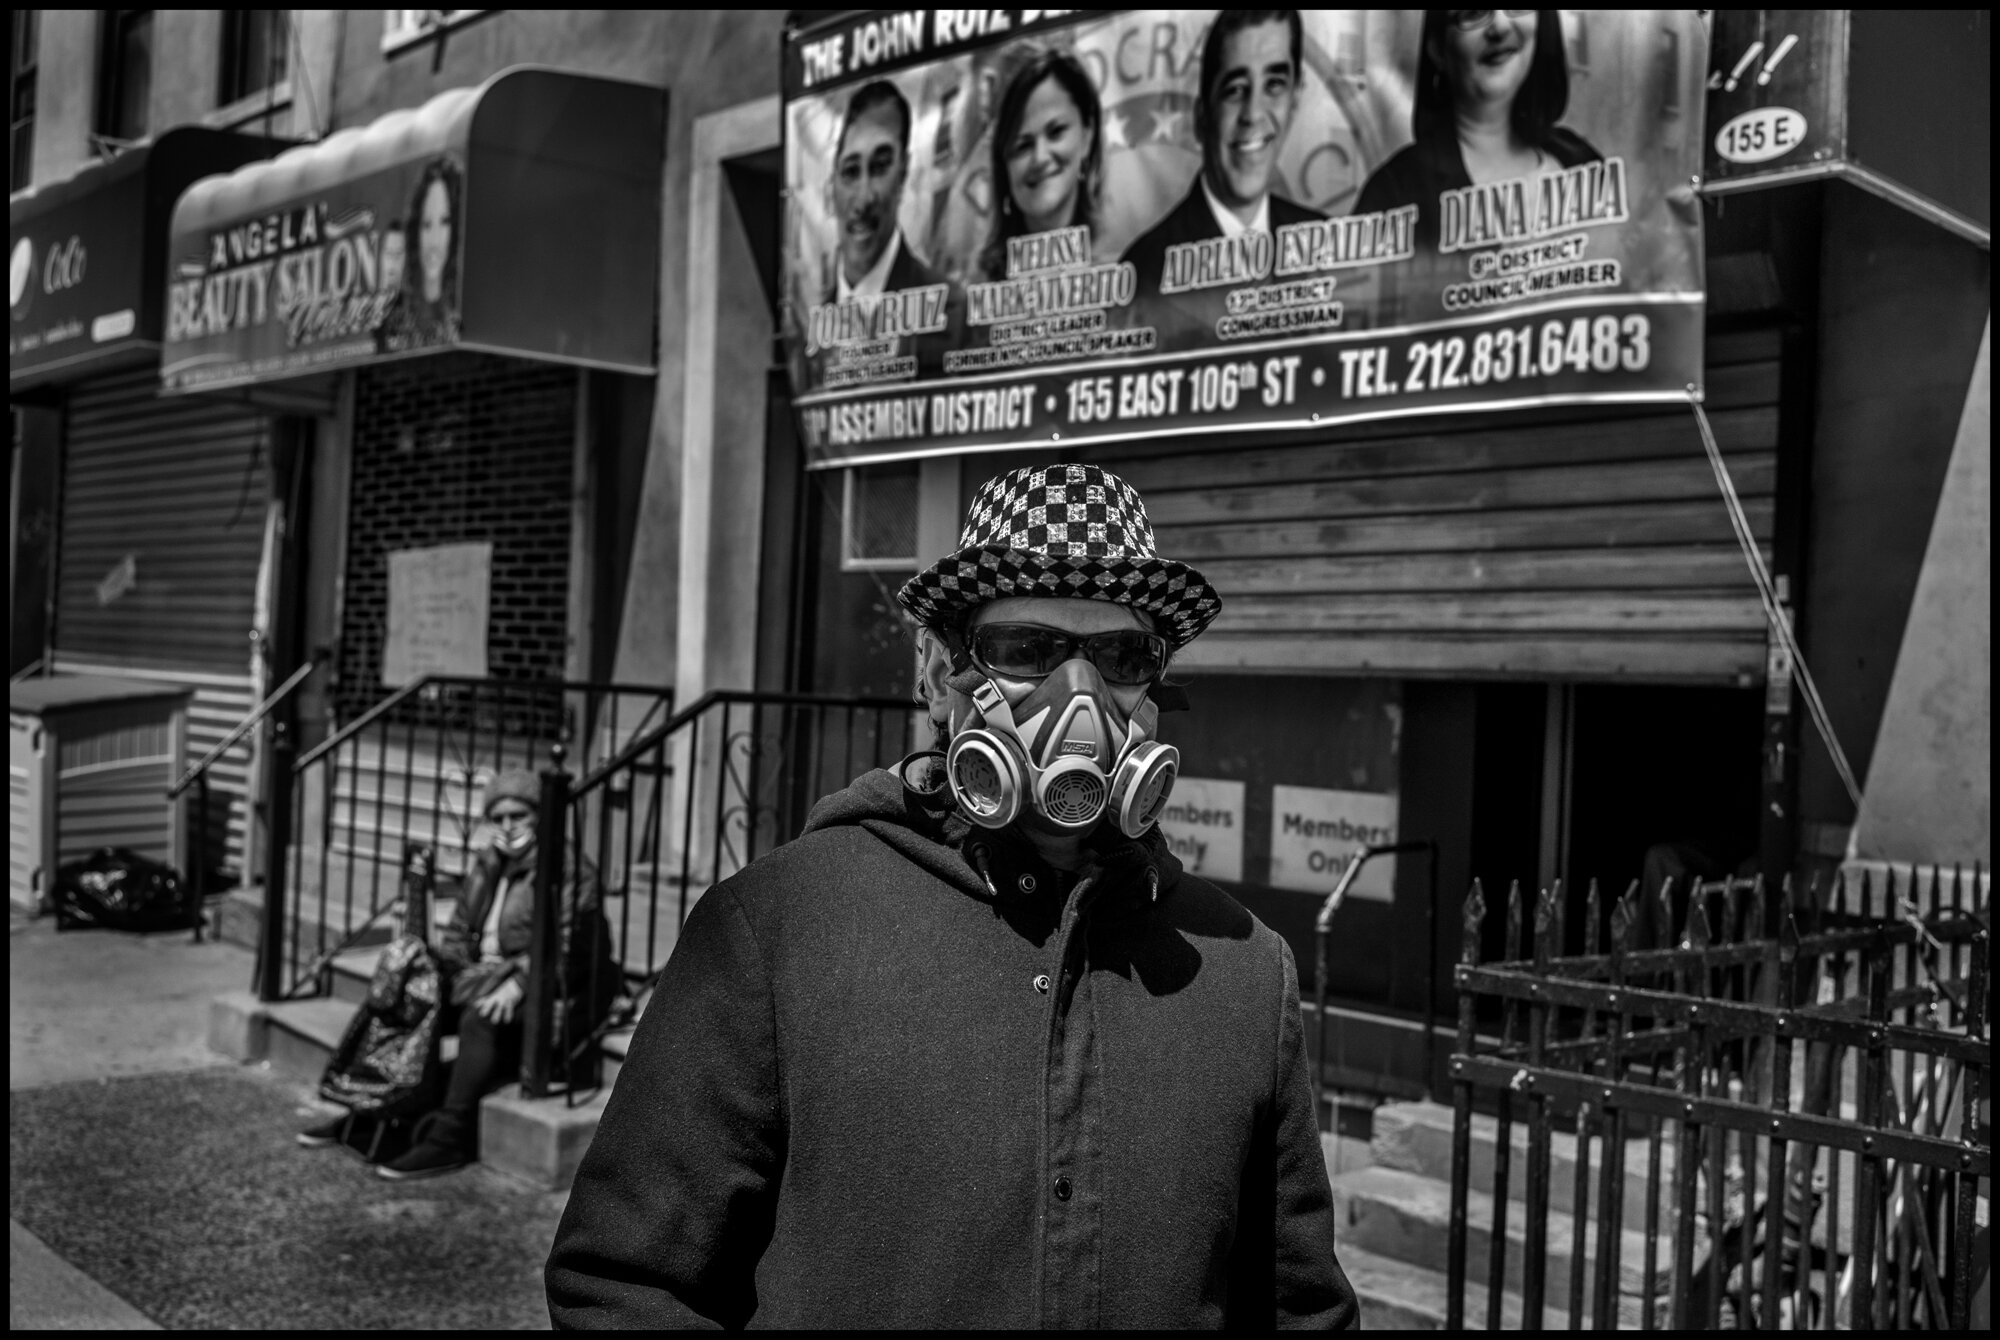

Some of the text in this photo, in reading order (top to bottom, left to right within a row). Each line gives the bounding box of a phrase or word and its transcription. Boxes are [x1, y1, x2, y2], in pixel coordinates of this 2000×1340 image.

[801, 10, 1011, 87] THE JOHN RUIZ
[1725, 116, 1798, 155] 155 E.
[1441, 159, 1628, 251] DIANA AYALA
[1009, 226, 1090, 277] MELISSA
[1161, 205, 1418, 293] ADRIANO ESPAILLAT
[1500, 237, 1586, 271] DISTRICT
[167, 259, 275, 342] BEAUTY
[276, 231, 379, 312] SALON
[1258, 280, 1334, 306] DISTRICT
[1445, 262, 1618, 307] COUNCIL MEMBER
[806, 283, 948, 356] JOHN RUIZ
[1218, 306, 1341, 336] CONGRESSMAN
[1087, 330, 1155, 352] SPEAKER
[828, 396, 927, 446] ASSEMBLY
[931, 384, 1036, 435] DISTRICT
[1067, 377, 1113, 423] 155
[1118, 369, 1184, 419] EAST
[1189, 361, 1258, 412] 106th
[1262, 356, 1301, 406] ST
[1338, 346, 1398, 398] TEL.
[1404, 314, 1650, 392] 212.831.6483
[1160, 801, 1234, 829] mbers
[1282, 813, 1392, 843] Members
[1307, 849, 1354, 876] Onl
